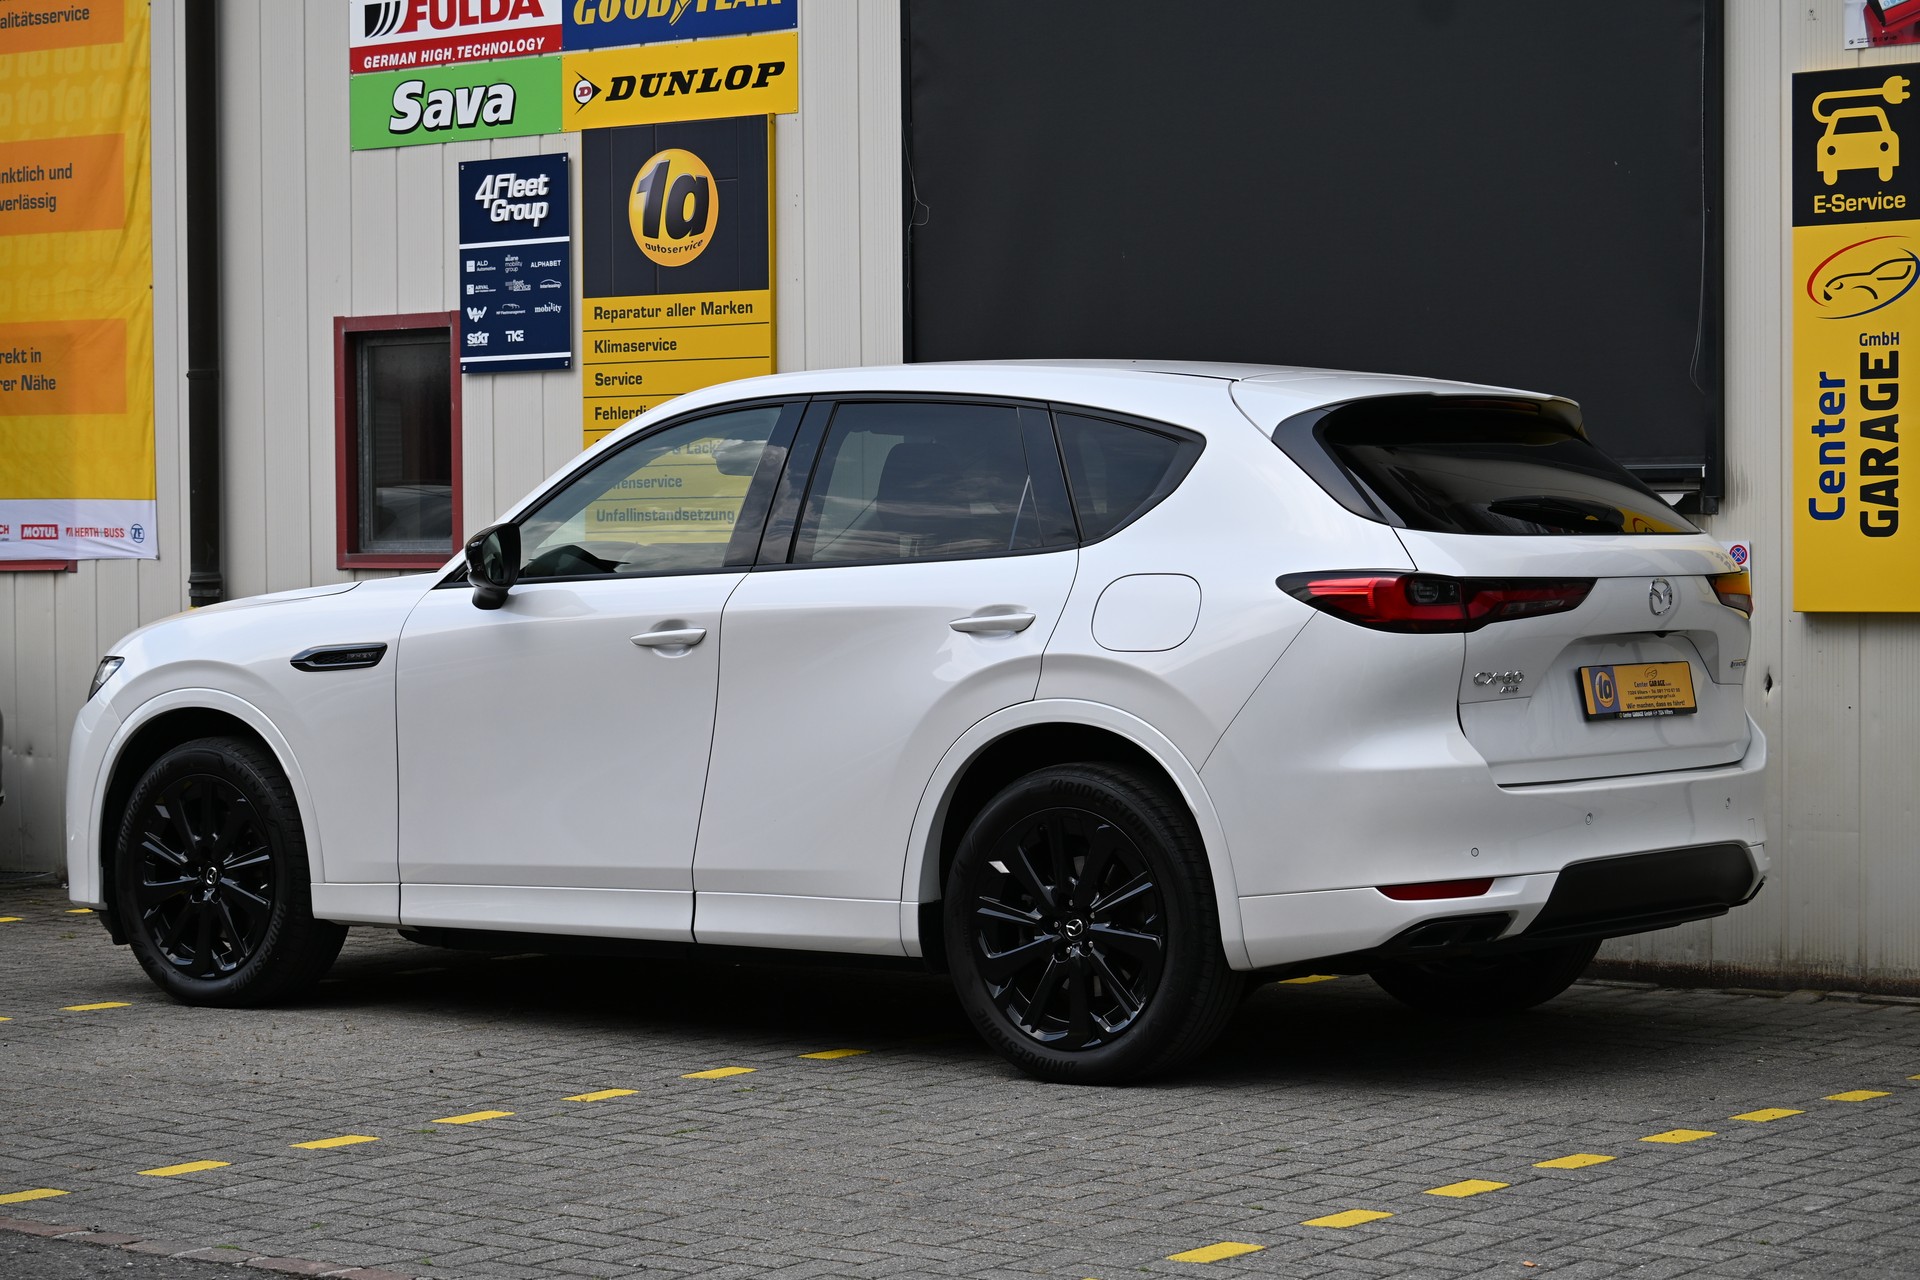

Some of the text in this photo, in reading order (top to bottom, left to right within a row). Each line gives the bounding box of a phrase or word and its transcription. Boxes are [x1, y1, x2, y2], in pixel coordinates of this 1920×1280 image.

[394, 0, 545, 35] FULDA
[363, 37, 546, 69] GERMAN HIGH TECHNOLOGY
[605, 61, 785, 102] DUNLOP
[389, 80, 517, 133] Sava
[49, 162, 73, 181] und
[475, 173, 550, 209] 4Fleet
[636, 159, 710, 240] 1a
[1813, 191, 1906, 214] E-Service
[490, 199, 549, 227] Group
[644, 239, 704, 255] autoservice
[530, 260, 561, 268] ALPHABET
[534, 301, 562, 313] mobility
[593, 300, 753, 323] Reparatur aller Marken
[594, 337, 678, 354] Klimaservice
[1859, 331, 1900, 347] GmbH
[30, 347, 41, 363] in
[21, 374, 57, 391] Nähe
[594, 370, 644, 387] Service
[594, 405, 650, 421] Fehlerdi
[1808, 371, 1846, 521] Center
[1860, 350, 1899, 538] GARAGE
[596, 507, 735, 524] Unfallinstandsetzung
[23, 527, 57, 538] MOTUL
[1473, 671, 1525, 686] CX-60
[1597, 675, 1612, 700] 1a
[1649, 680, 1665, 688] GARAGE
